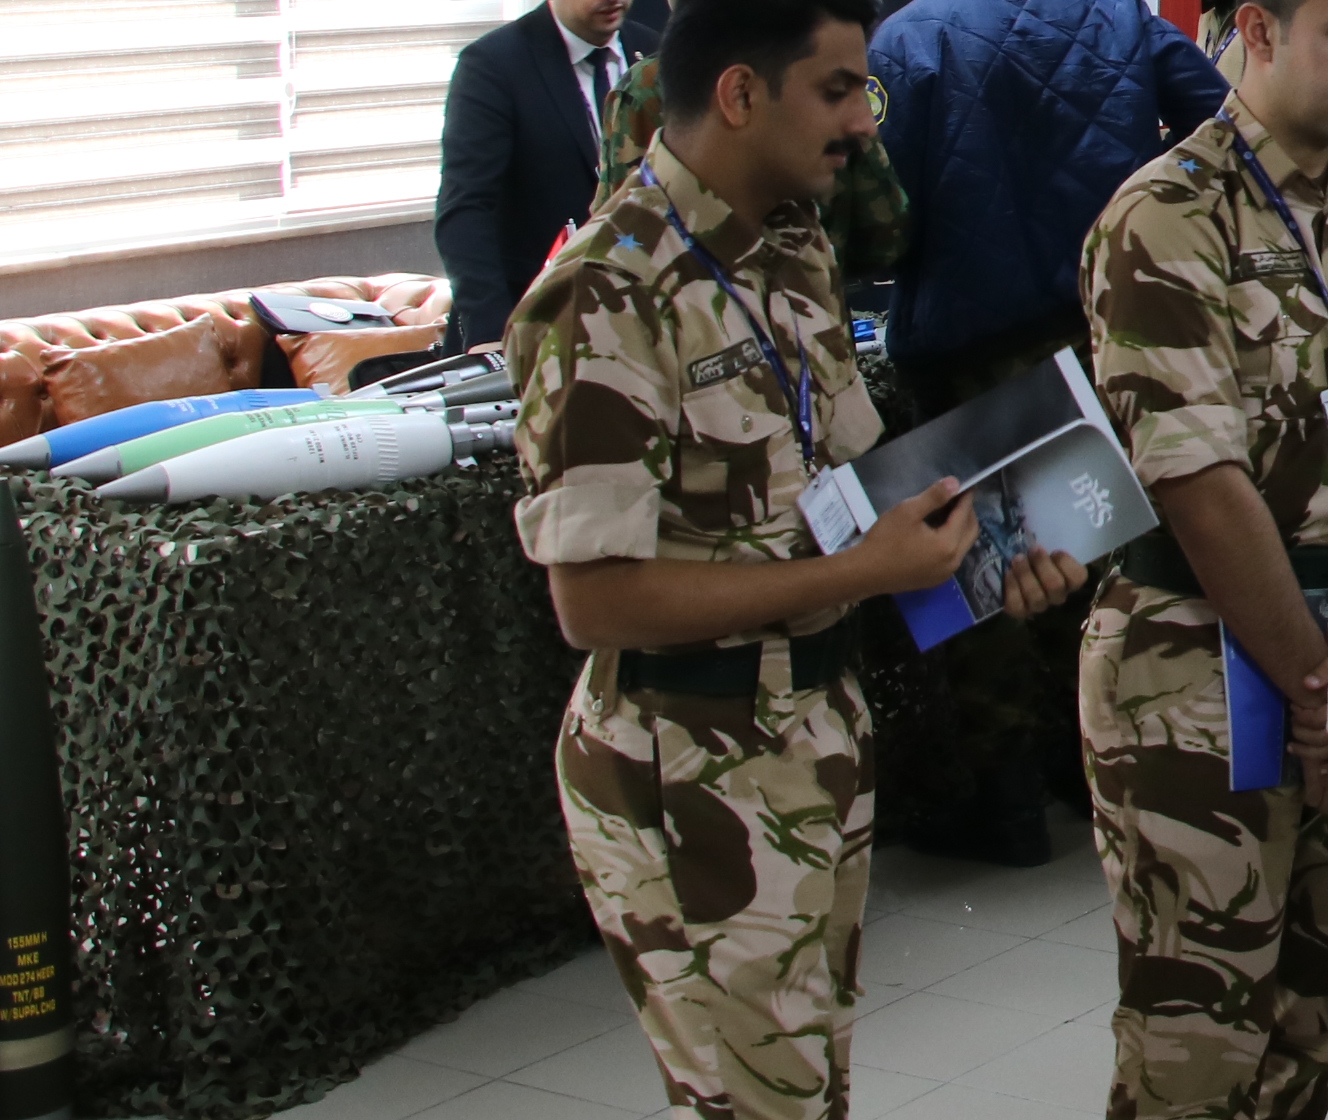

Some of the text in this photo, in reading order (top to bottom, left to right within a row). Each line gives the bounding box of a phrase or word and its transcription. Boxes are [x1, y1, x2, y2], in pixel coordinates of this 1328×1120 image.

[7, 932, 41, 950] 155MM
[17, 952, 39, 967] MKE
[0, 965, 55, 987] MOD 274 HEER
[0, 1004, 40, 1021] W/SUPPL
